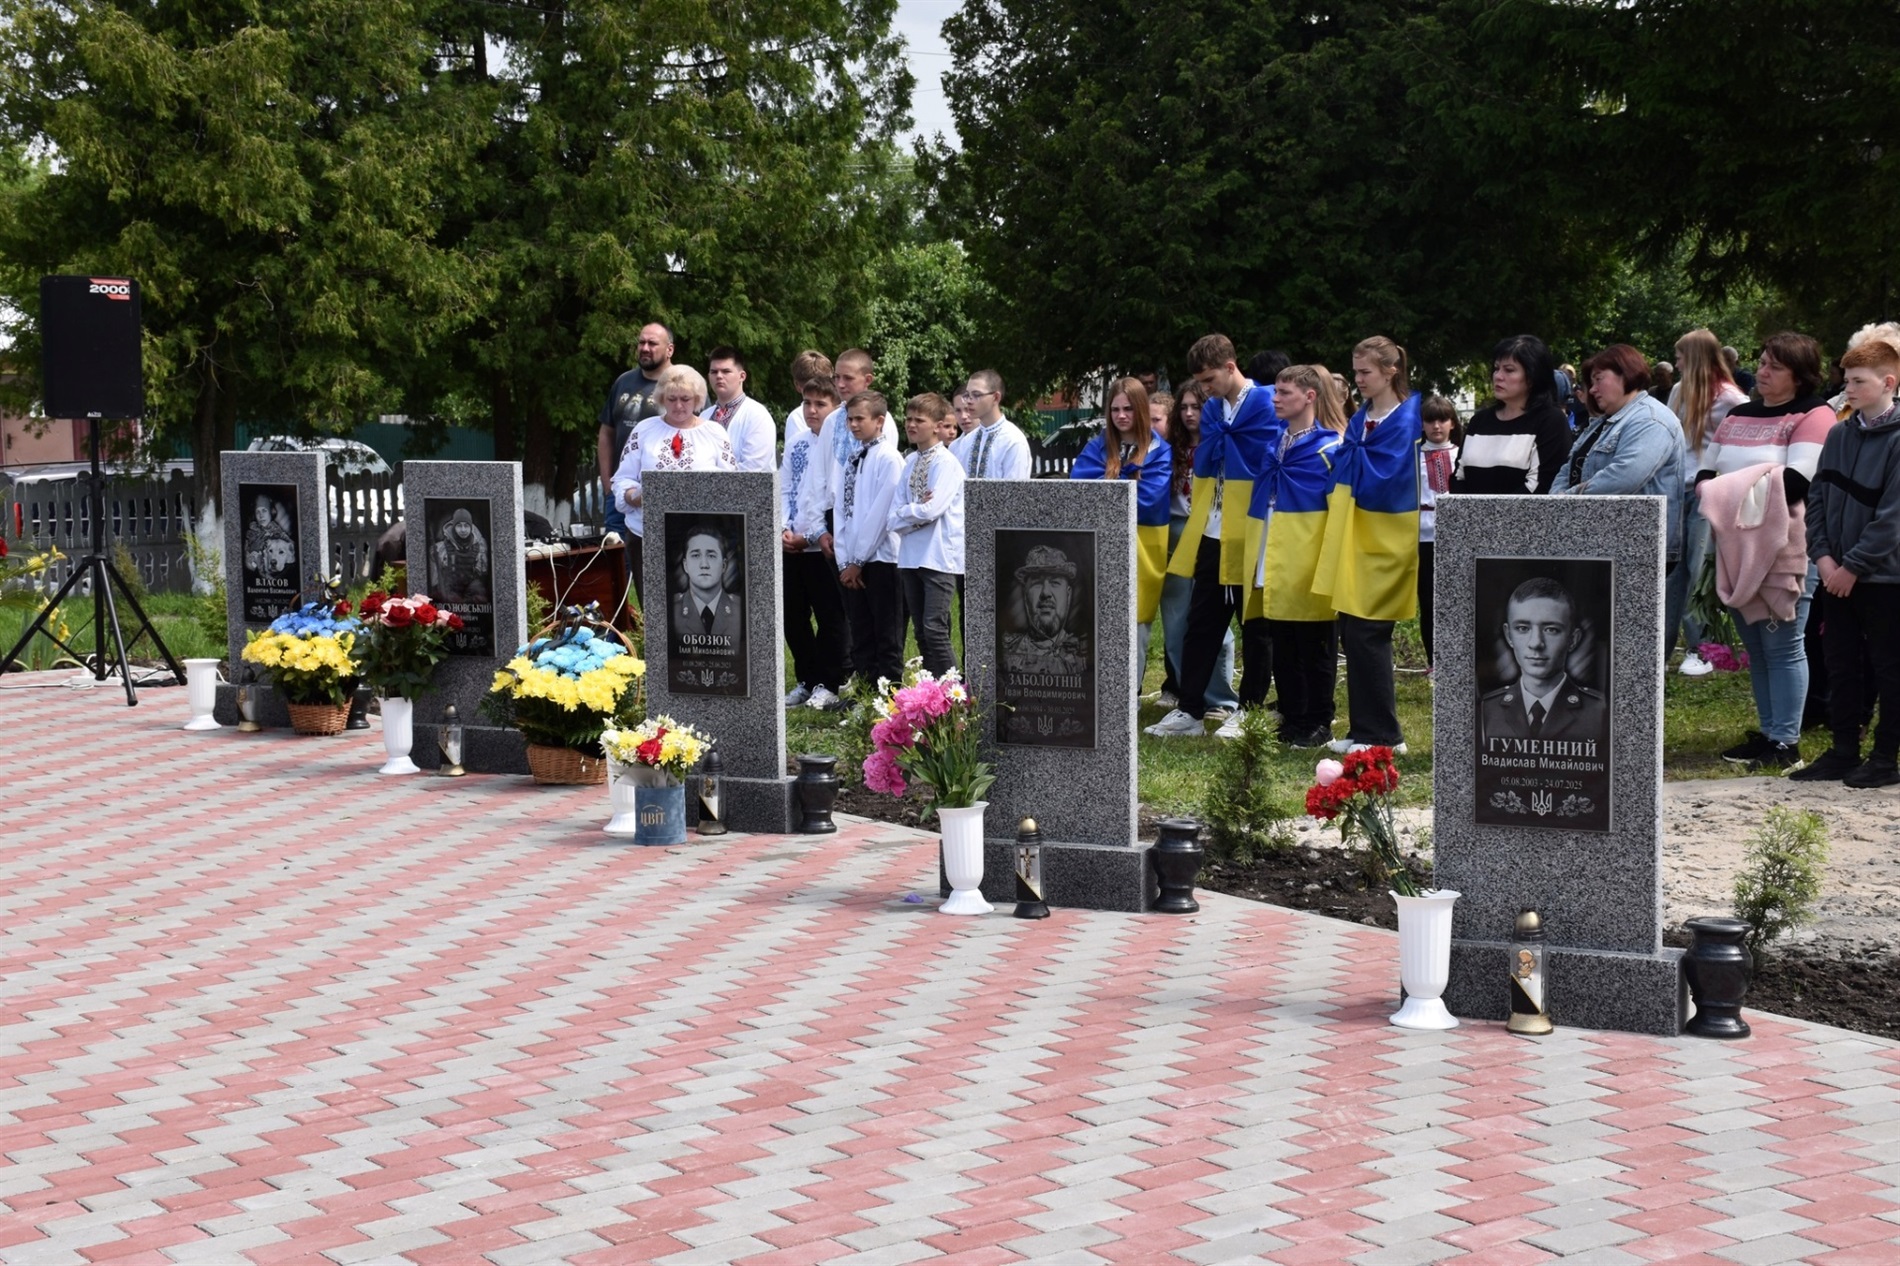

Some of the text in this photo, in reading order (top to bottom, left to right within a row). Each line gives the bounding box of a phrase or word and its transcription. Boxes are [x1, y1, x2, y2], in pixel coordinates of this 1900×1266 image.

[255, 577, 289, 587] ВЛАСОВ
[683, 634, 731, 646] ОБОЗЮК
[1023, 687, 1086, 700] Володимирович
[1489, 737, 1597, 757] ГУМЕННИЙ
[1481, 754, 1604, 772] Владислав Михайлович
[1500, 776, 1538, 787] 05.08.2003
[1545, 779, 1583, 790] 24.07.2025
